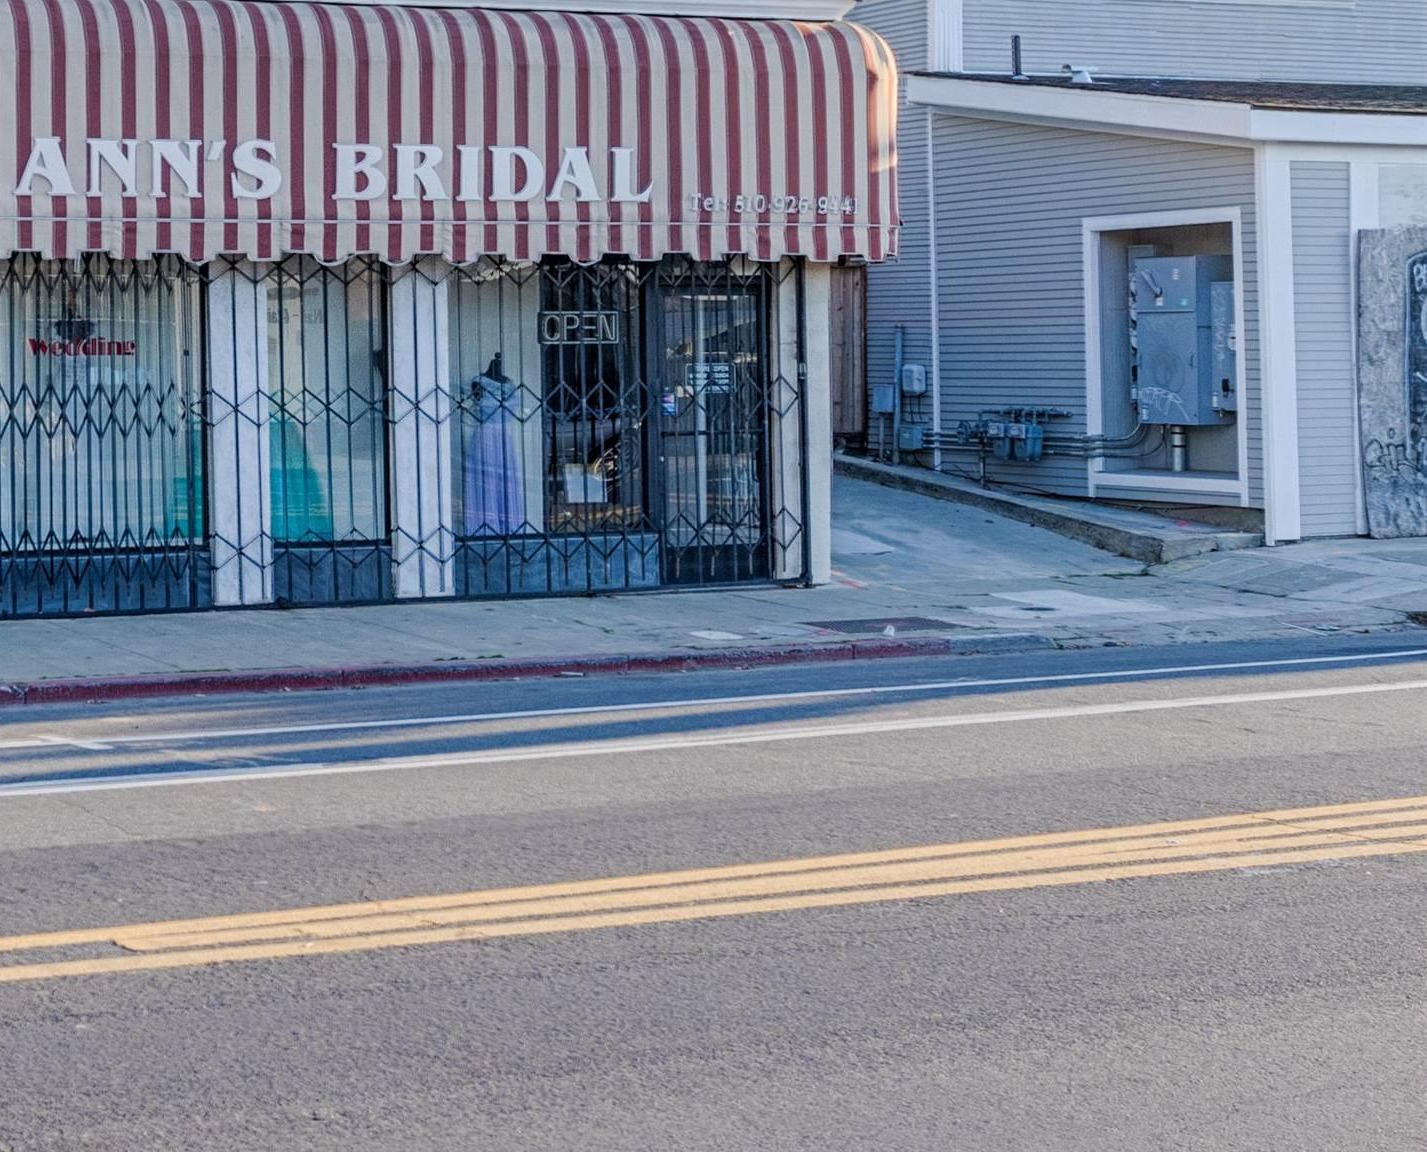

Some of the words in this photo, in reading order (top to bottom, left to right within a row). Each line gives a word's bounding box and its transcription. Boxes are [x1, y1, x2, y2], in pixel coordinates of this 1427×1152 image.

[12, 136, 282, 200] ANN'S
[332, 143, 653, 202] BRIDAL
[544, 314, 615, 341] OPEN
[28, 336, 136, 356] Wedding
